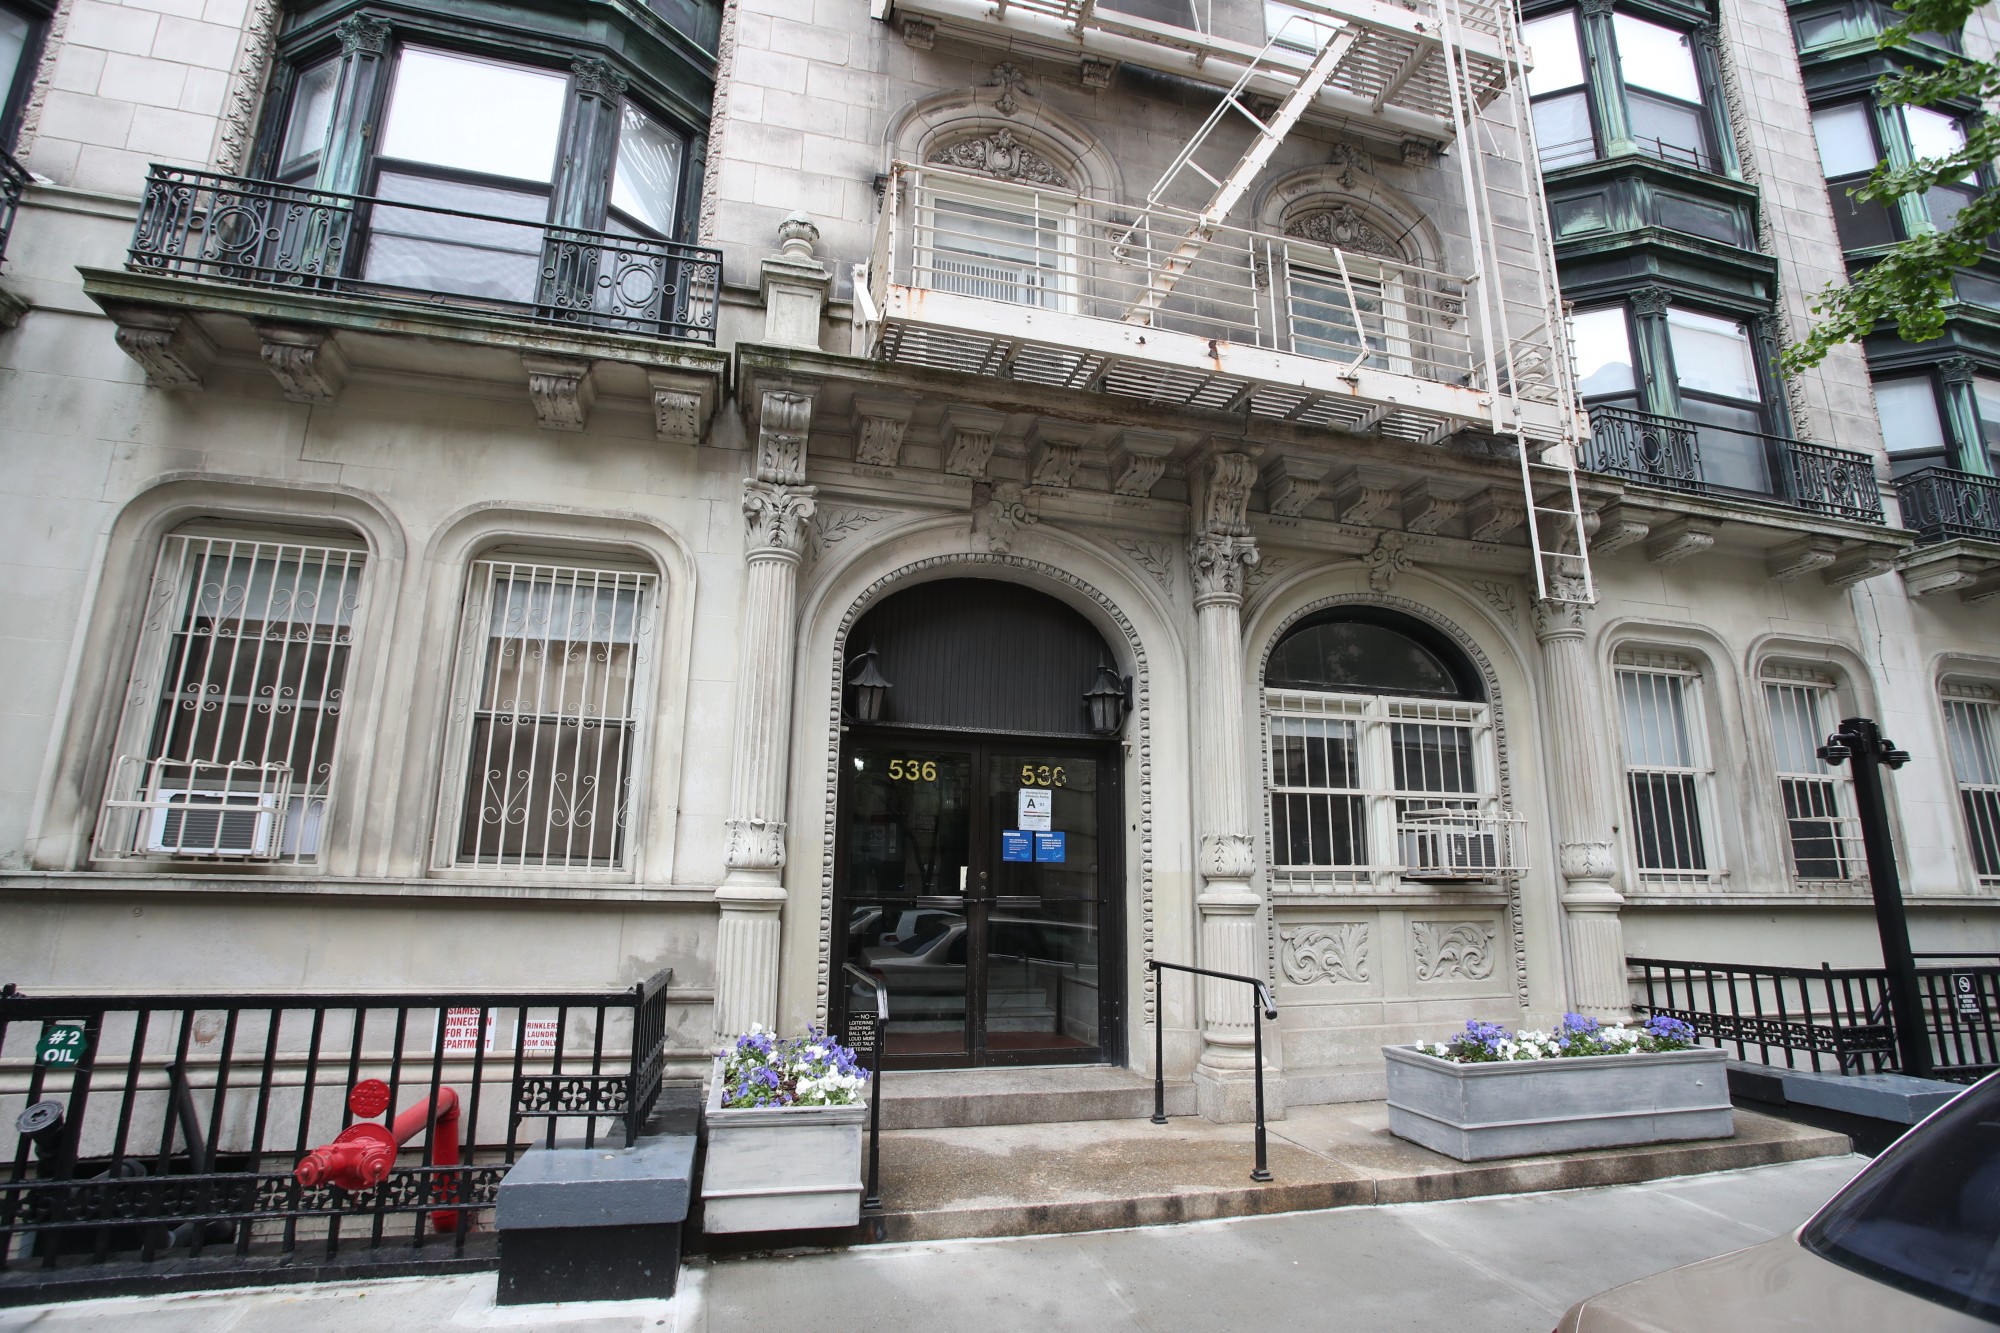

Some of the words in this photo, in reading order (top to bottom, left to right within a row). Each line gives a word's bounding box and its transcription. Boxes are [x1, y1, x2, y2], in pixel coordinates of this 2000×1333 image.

[887, 759, 937, 782] 536
[1027, 798, 1036, 808] A
[448, 1007, 480, 1015] SIAMES
[445, 1028, 461, 1037] FOR
[465, 1028, 479, 1037] FIR
[43, 1048, 76, 1062] OIL
